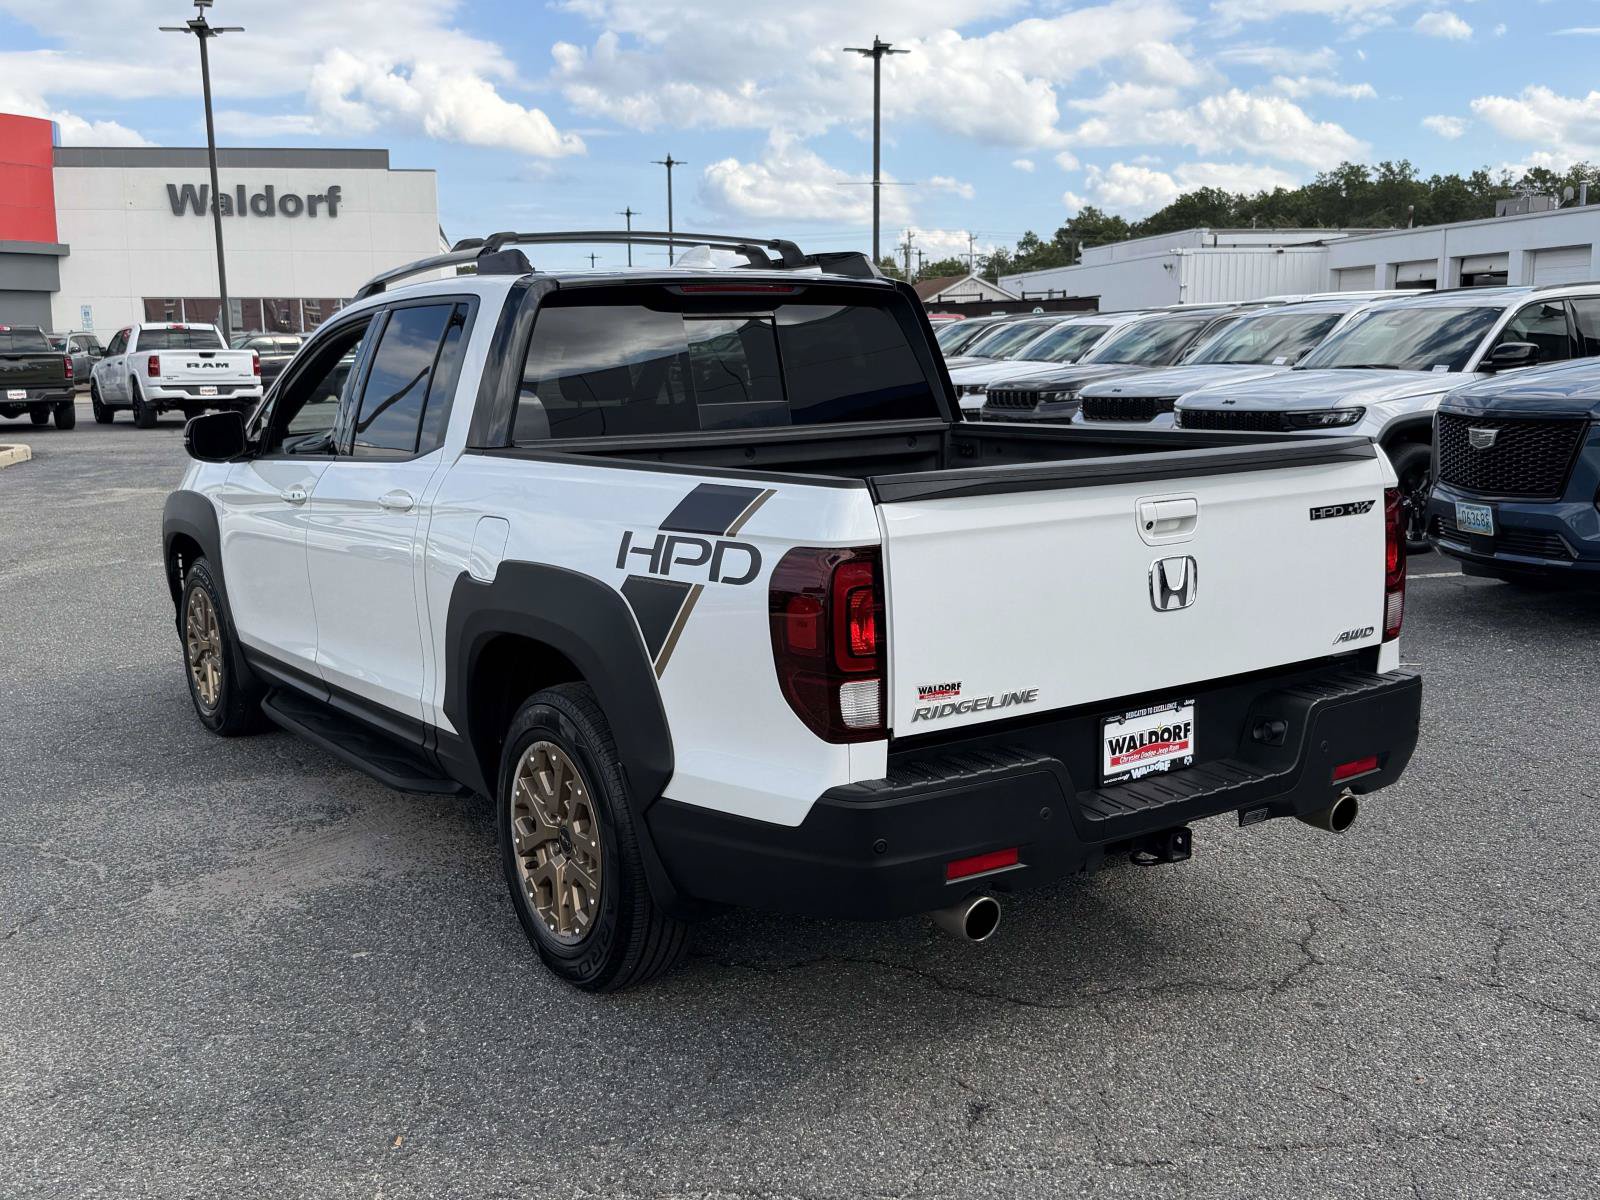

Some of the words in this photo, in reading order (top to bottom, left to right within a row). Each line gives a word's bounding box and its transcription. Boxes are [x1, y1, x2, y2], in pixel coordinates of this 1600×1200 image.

[166, 183, 342, 218] Waldorf
[1311, 505, 1345, 520] HPD
[615, 530, 763, 586] HPD
[1332, 626, 1375, 645] AWD
[918, 682, 962, 695] WALDORF
[911, 688, 1039, 723] RIDGELINE
[1125, 708, 1147, 720] DEDICATED
[1147, 706, 1153, 715] TO
[1153, 701, 1178, 714] EXCELLENCE
[1107, 721, 1192, 756] WALDORF
[1130, 759, 1171, 780] WALDORF
